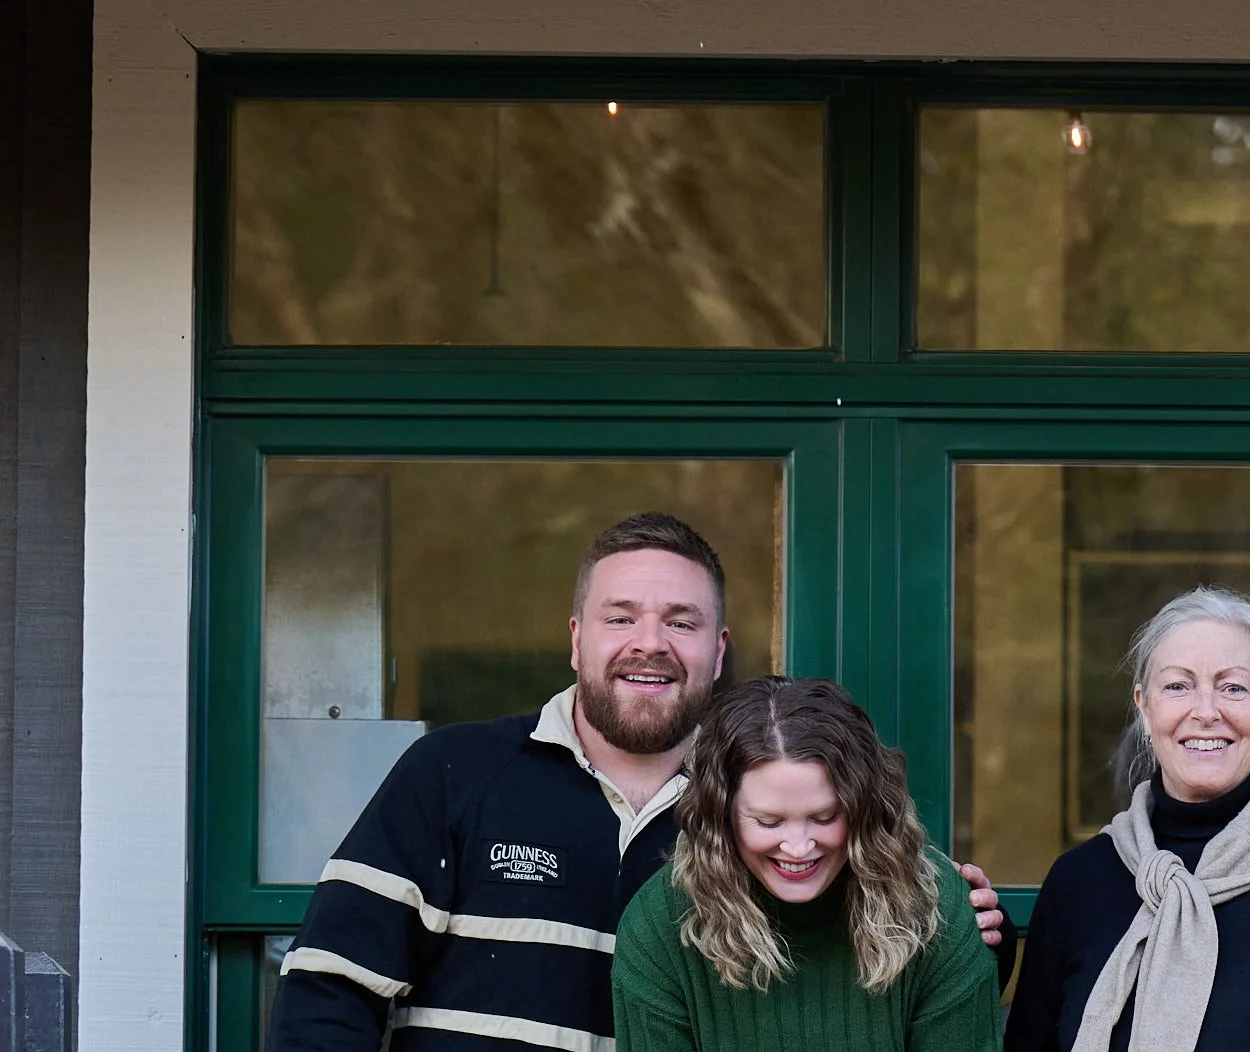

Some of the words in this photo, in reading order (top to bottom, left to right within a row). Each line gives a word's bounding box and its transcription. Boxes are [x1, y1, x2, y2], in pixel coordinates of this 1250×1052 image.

[490, 843, 558, 869] GUINNESS
[503, 872, 543, 881] TRADEMARK
[514, 862, 533, 871] 1759
[536, 864, 559, 879] IRELAND
